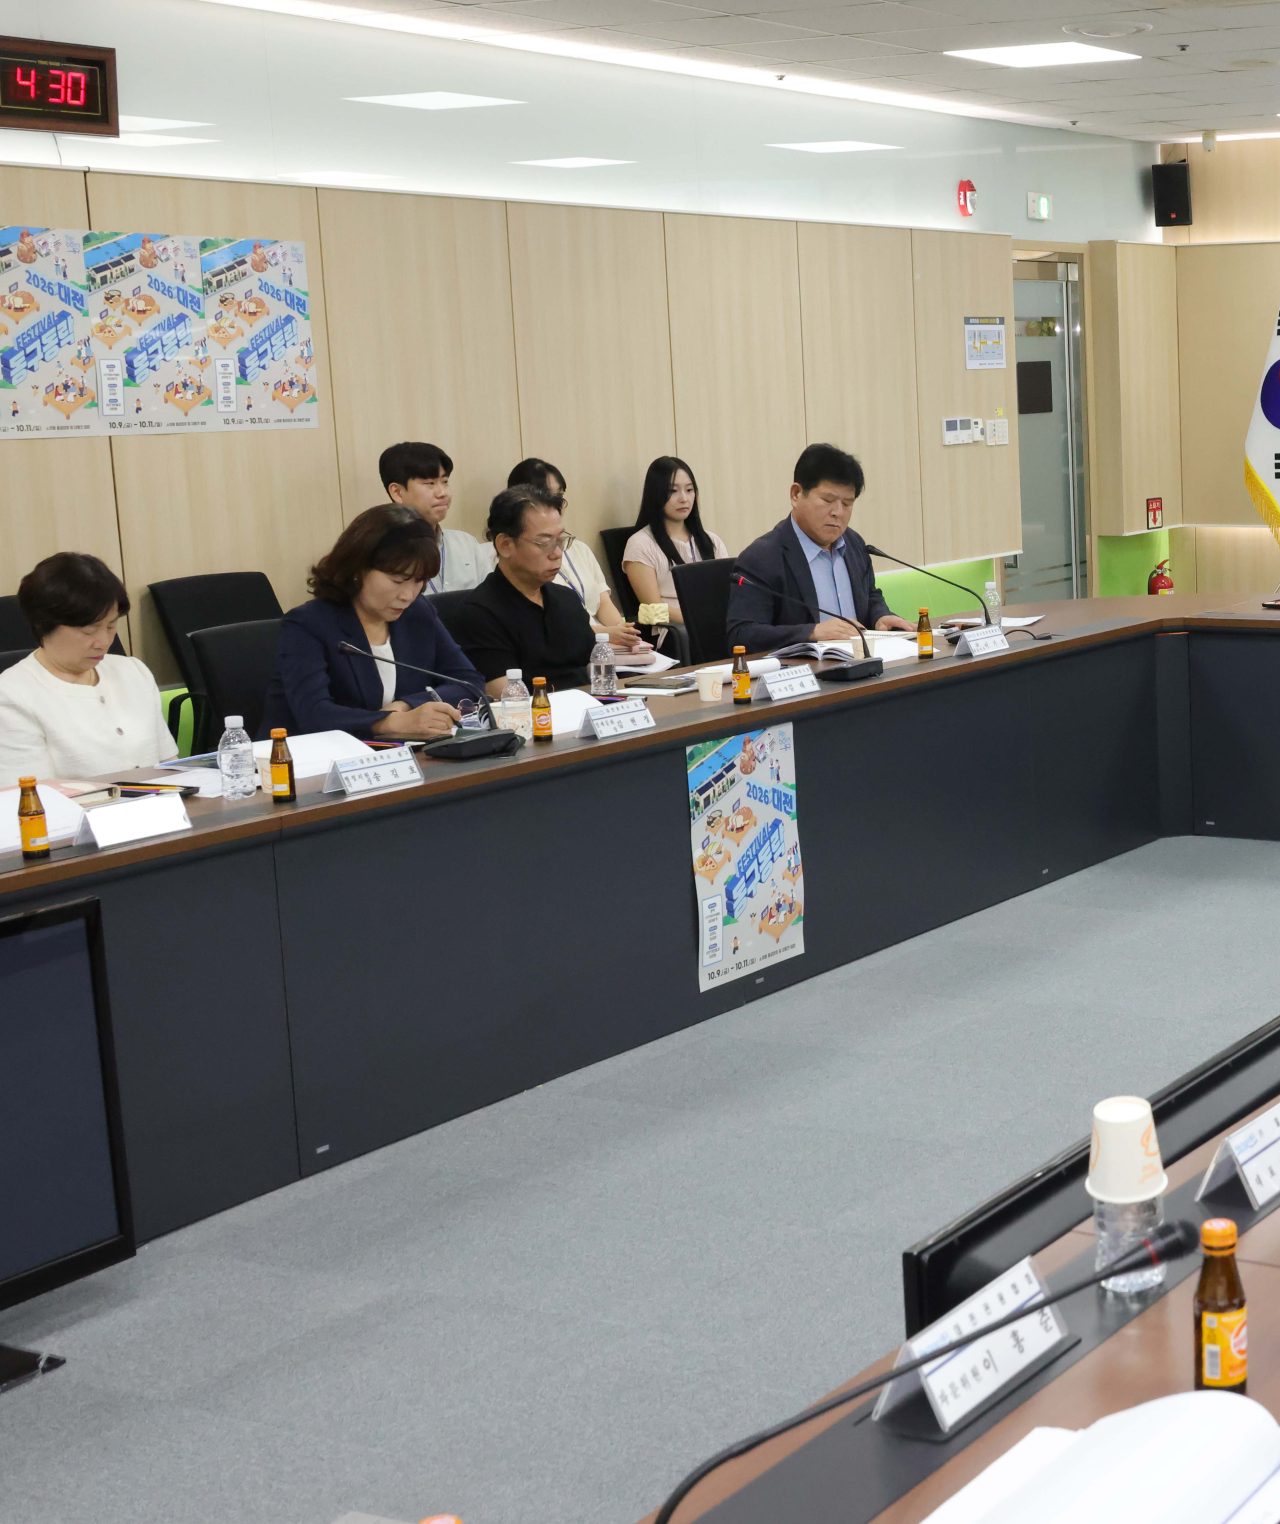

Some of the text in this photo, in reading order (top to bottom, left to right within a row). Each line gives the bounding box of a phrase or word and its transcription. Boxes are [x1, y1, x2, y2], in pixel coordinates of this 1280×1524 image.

[24, 269, 86, 315] 2026 대전
[147, 274, 202, 318] 2026 대전
[258, 278, 308, 315] 2026 대전
[15, 312, 58, 350] FESTIVAL
[139, 313, 178, 350] FESTIVAL
[248, 315, 287, 350] FESTIVAL
[746, 781, 794, 815] 2026 대전
[737, 822, 772, 876] FESTIVAL
